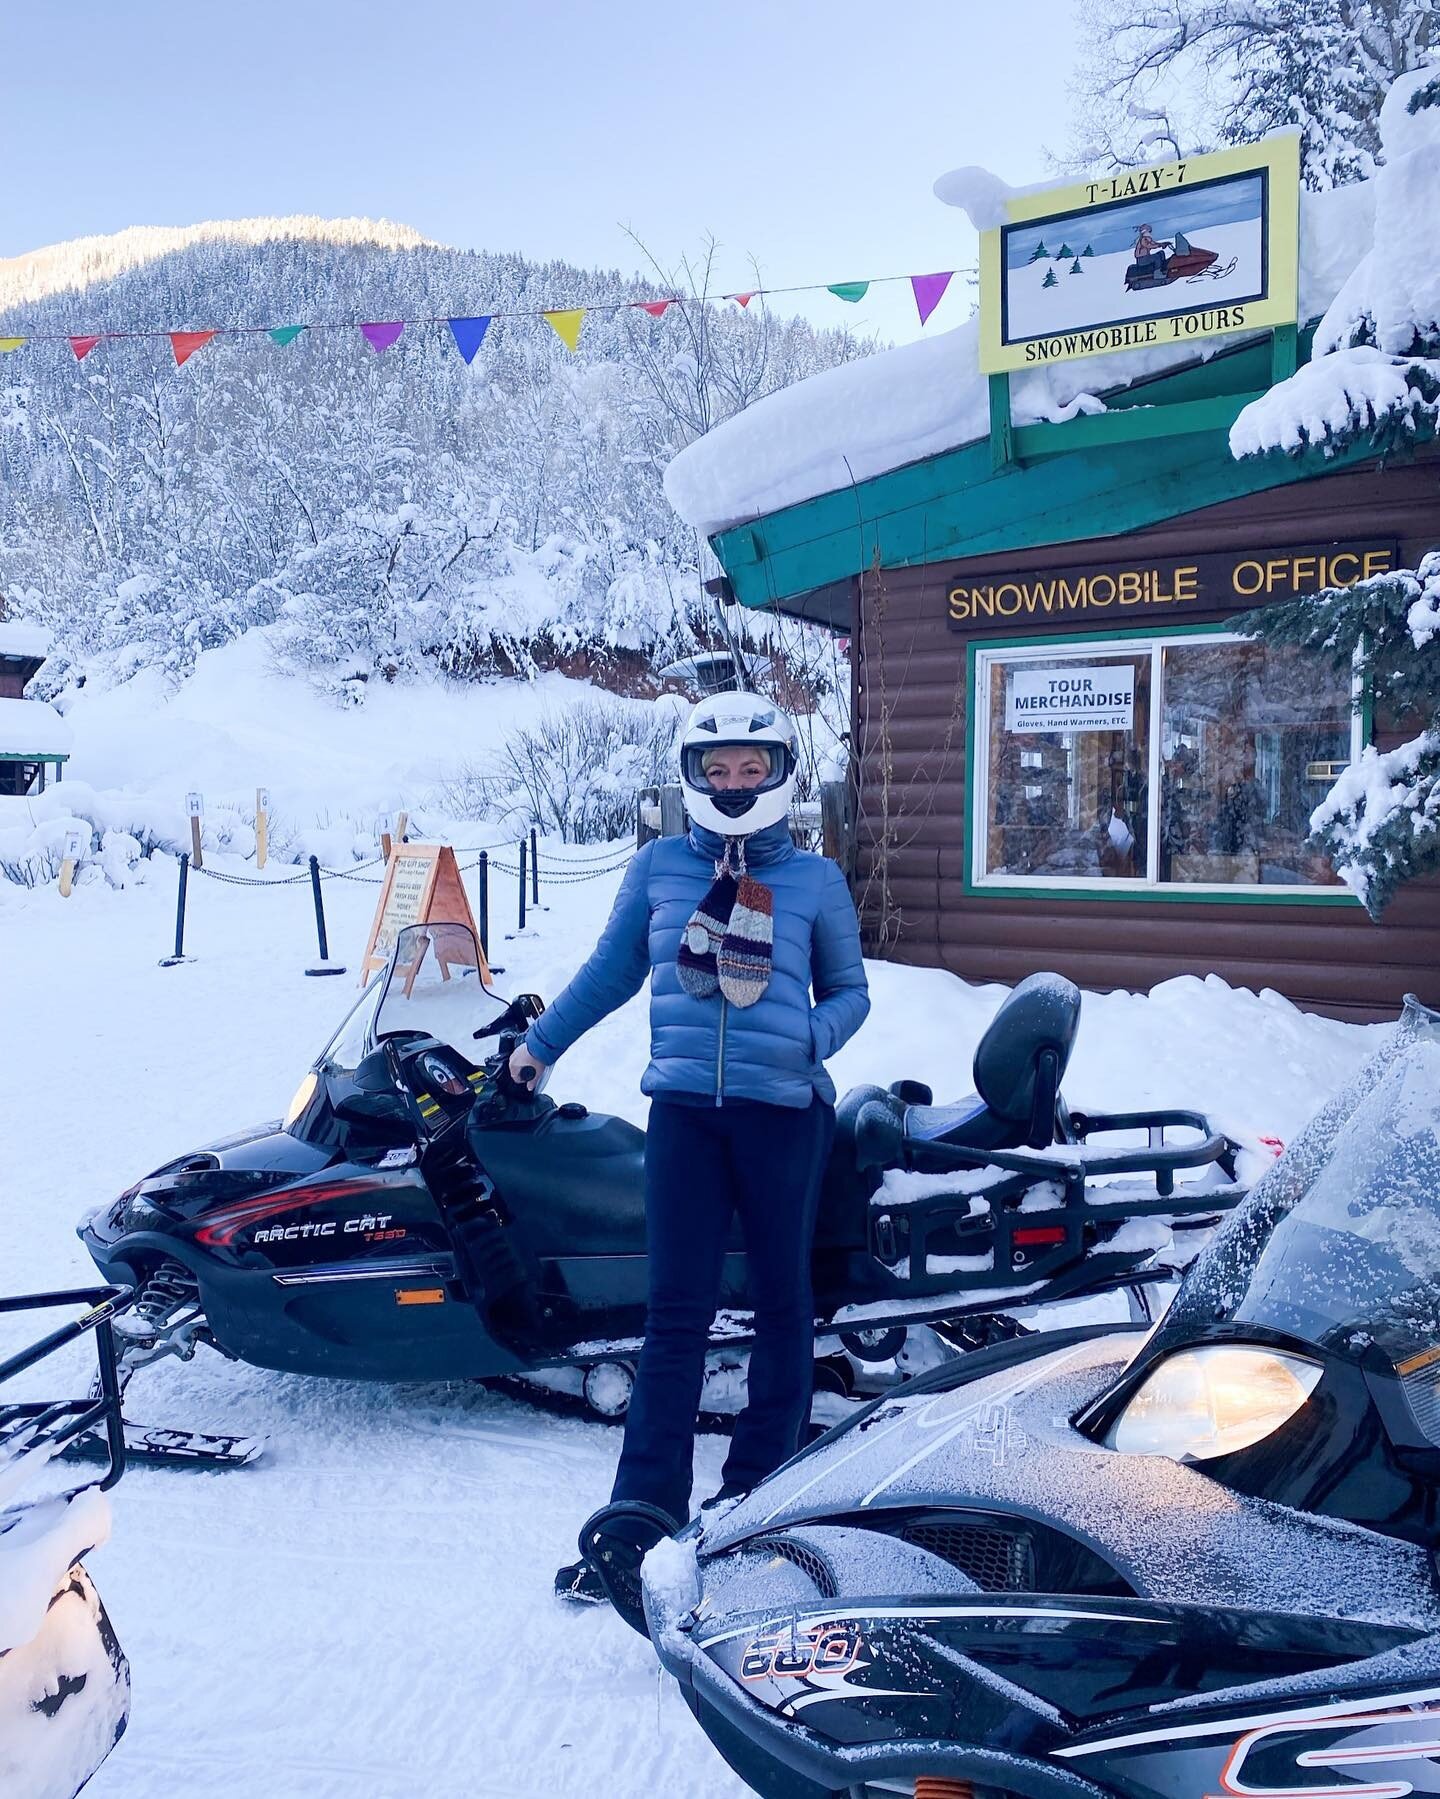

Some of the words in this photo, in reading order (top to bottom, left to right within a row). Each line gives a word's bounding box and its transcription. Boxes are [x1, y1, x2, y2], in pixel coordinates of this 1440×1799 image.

[1086, 164, 1186, 204] T-LAZY-7
[1025, 322, 1157, 362] SNOWMOBILE
[1170, 307, 1245, 337] TOURS
[949, 566, 1198, 619] SNOWMOBILE
[1048, 679, 1092, 692] TOUR
[1015, 692, 1132, 709] MERCHANDISE
[1017, 720, 1045, 728] Gloves,
[1070, 718, 1109, 726] Warmers,
[190, 800, 199, 811] H
[69, 841, 77, 852] F
[254, 1221, 337, 1243] ARCTIC
[343, 1215, 392, 1233] CAT
